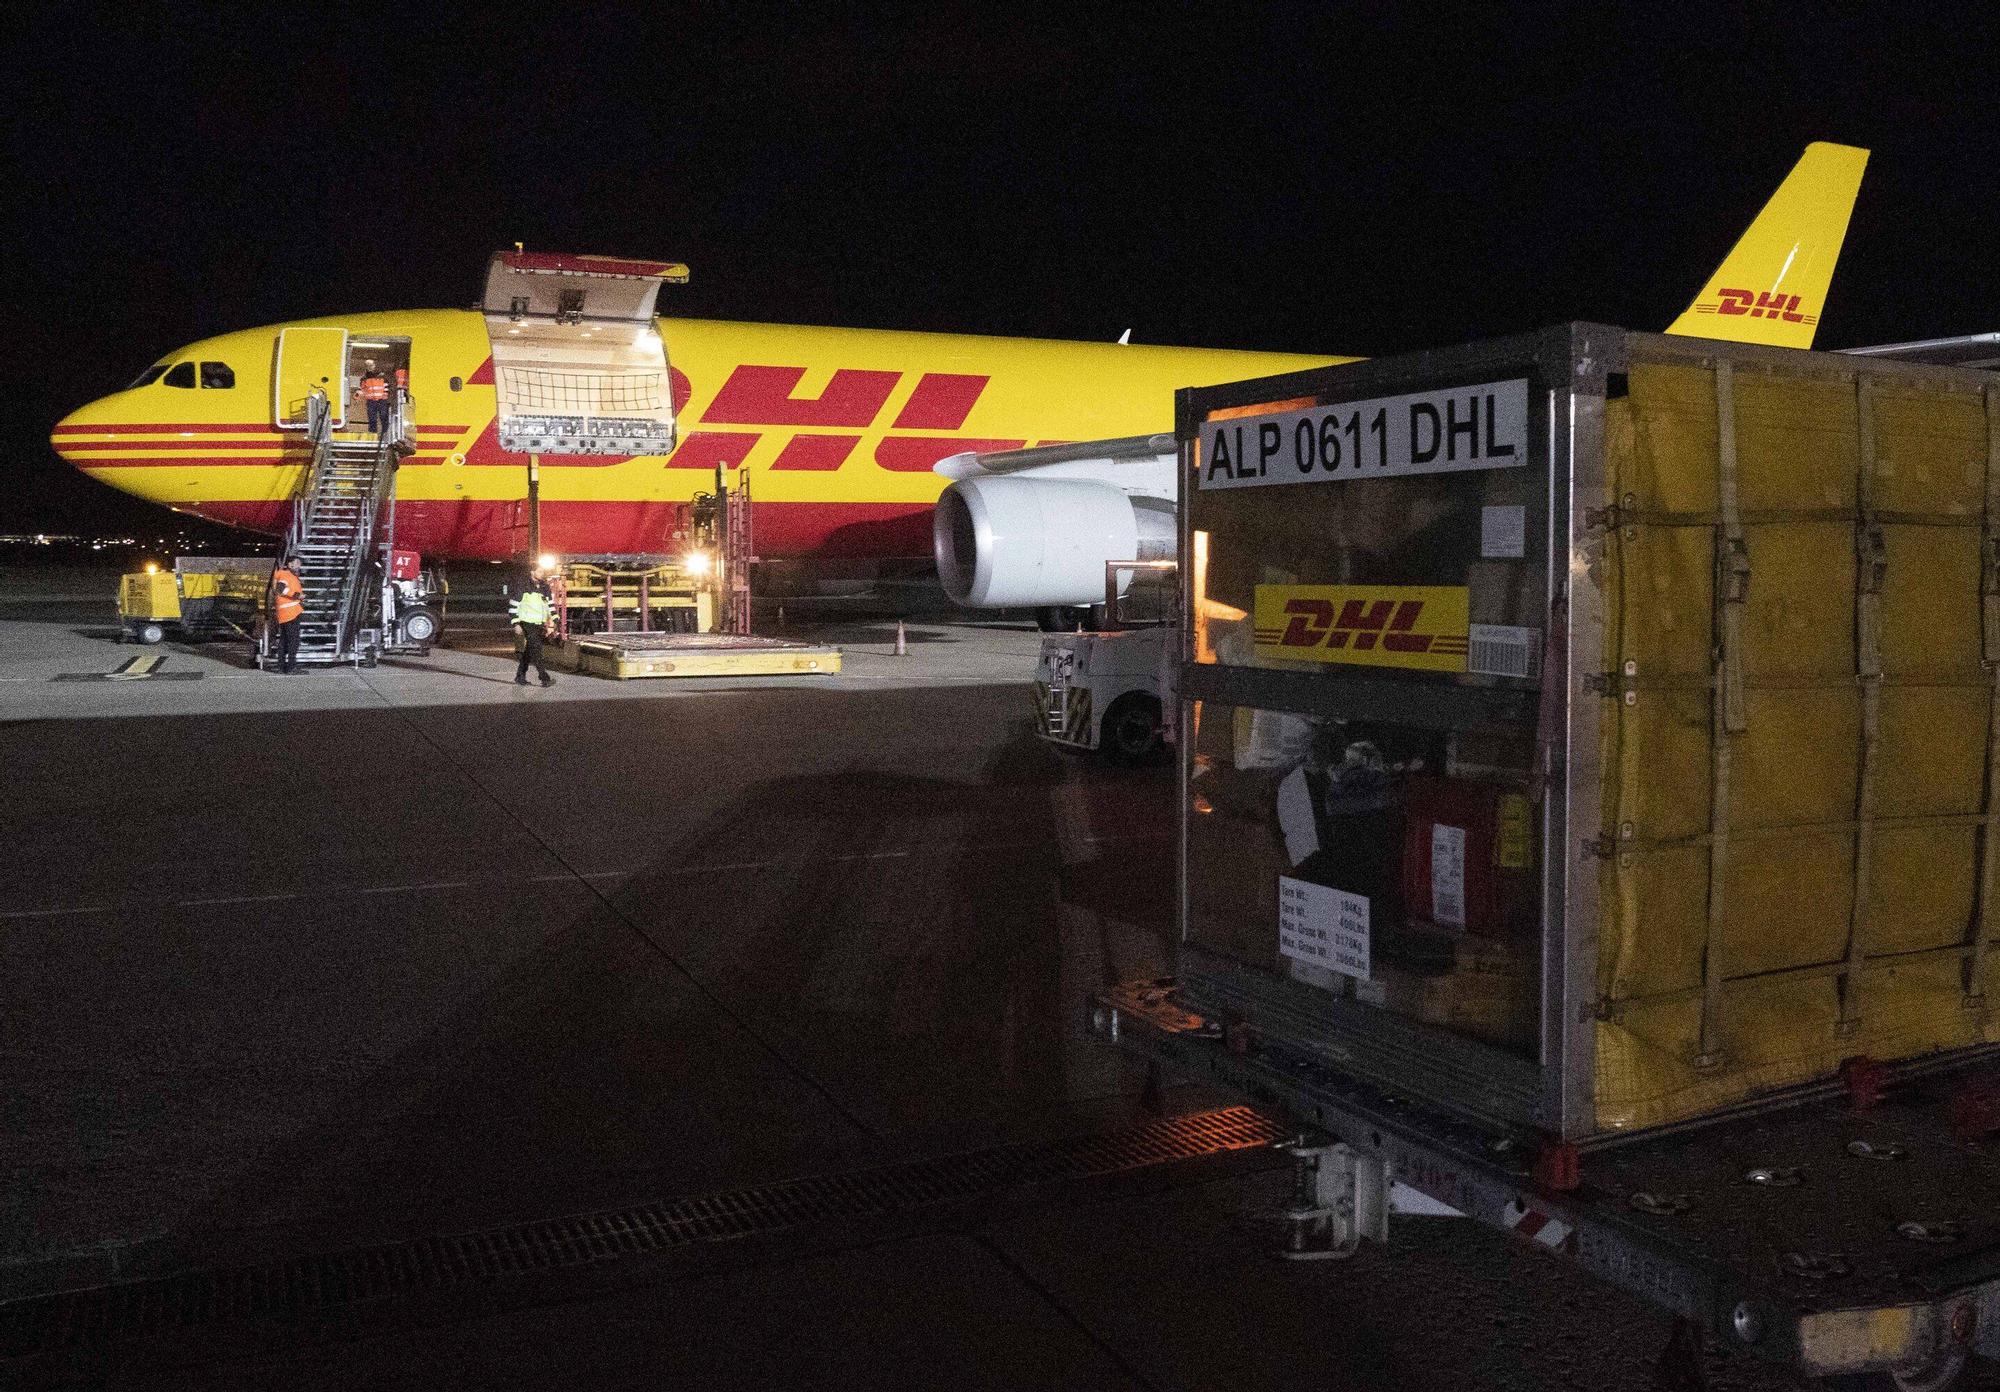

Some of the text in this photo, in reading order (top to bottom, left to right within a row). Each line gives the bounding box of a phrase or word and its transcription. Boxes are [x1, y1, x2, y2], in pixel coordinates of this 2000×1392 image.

[1718, 288, 1803, 323] DHL
[1207, 394, 1515, 481] ALP 0611 DHL
[1281, 599, 1435, 653] DHL
